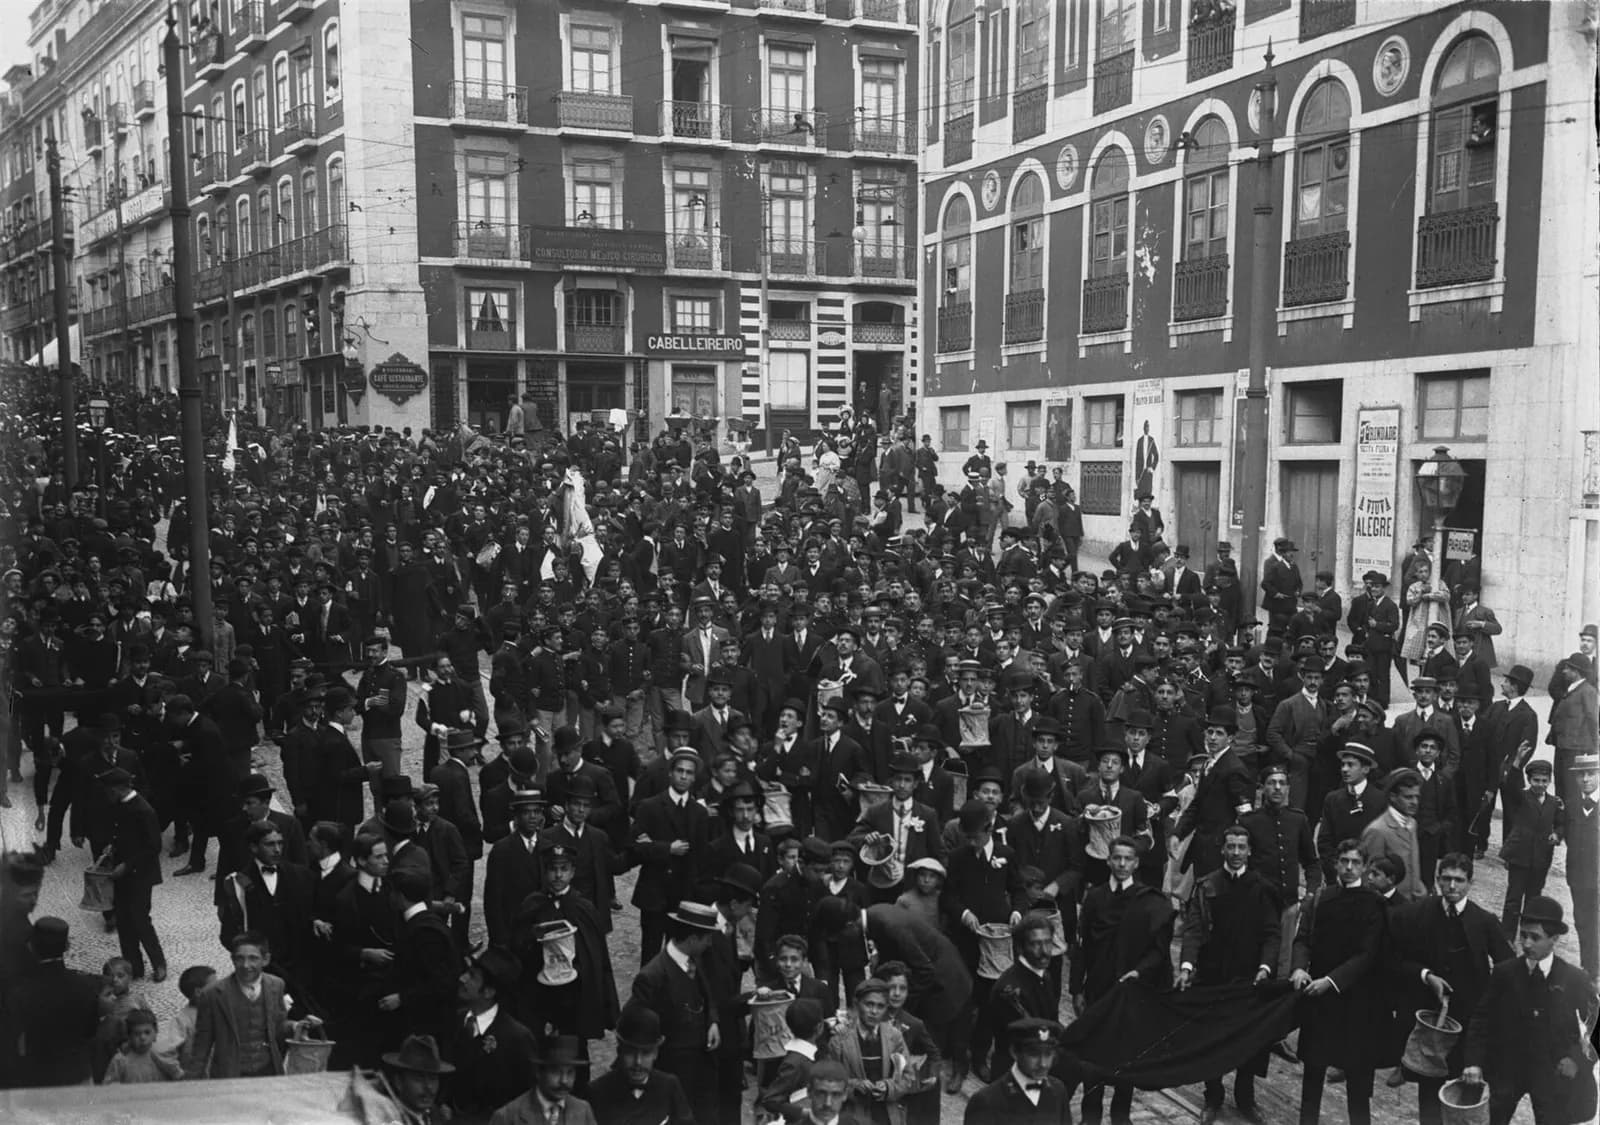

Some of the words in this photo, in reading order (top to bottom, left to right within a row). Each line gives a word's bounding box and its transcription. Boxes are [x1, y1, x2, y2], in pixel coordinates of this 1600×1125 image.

[648, 336, 743, 351] CABELLEIREIRO
[1358, 496, 1365, 511] A
[1367, 496, 1392, 515] VIUVA
[1355, 517, 1392, 537] ALEGRE
